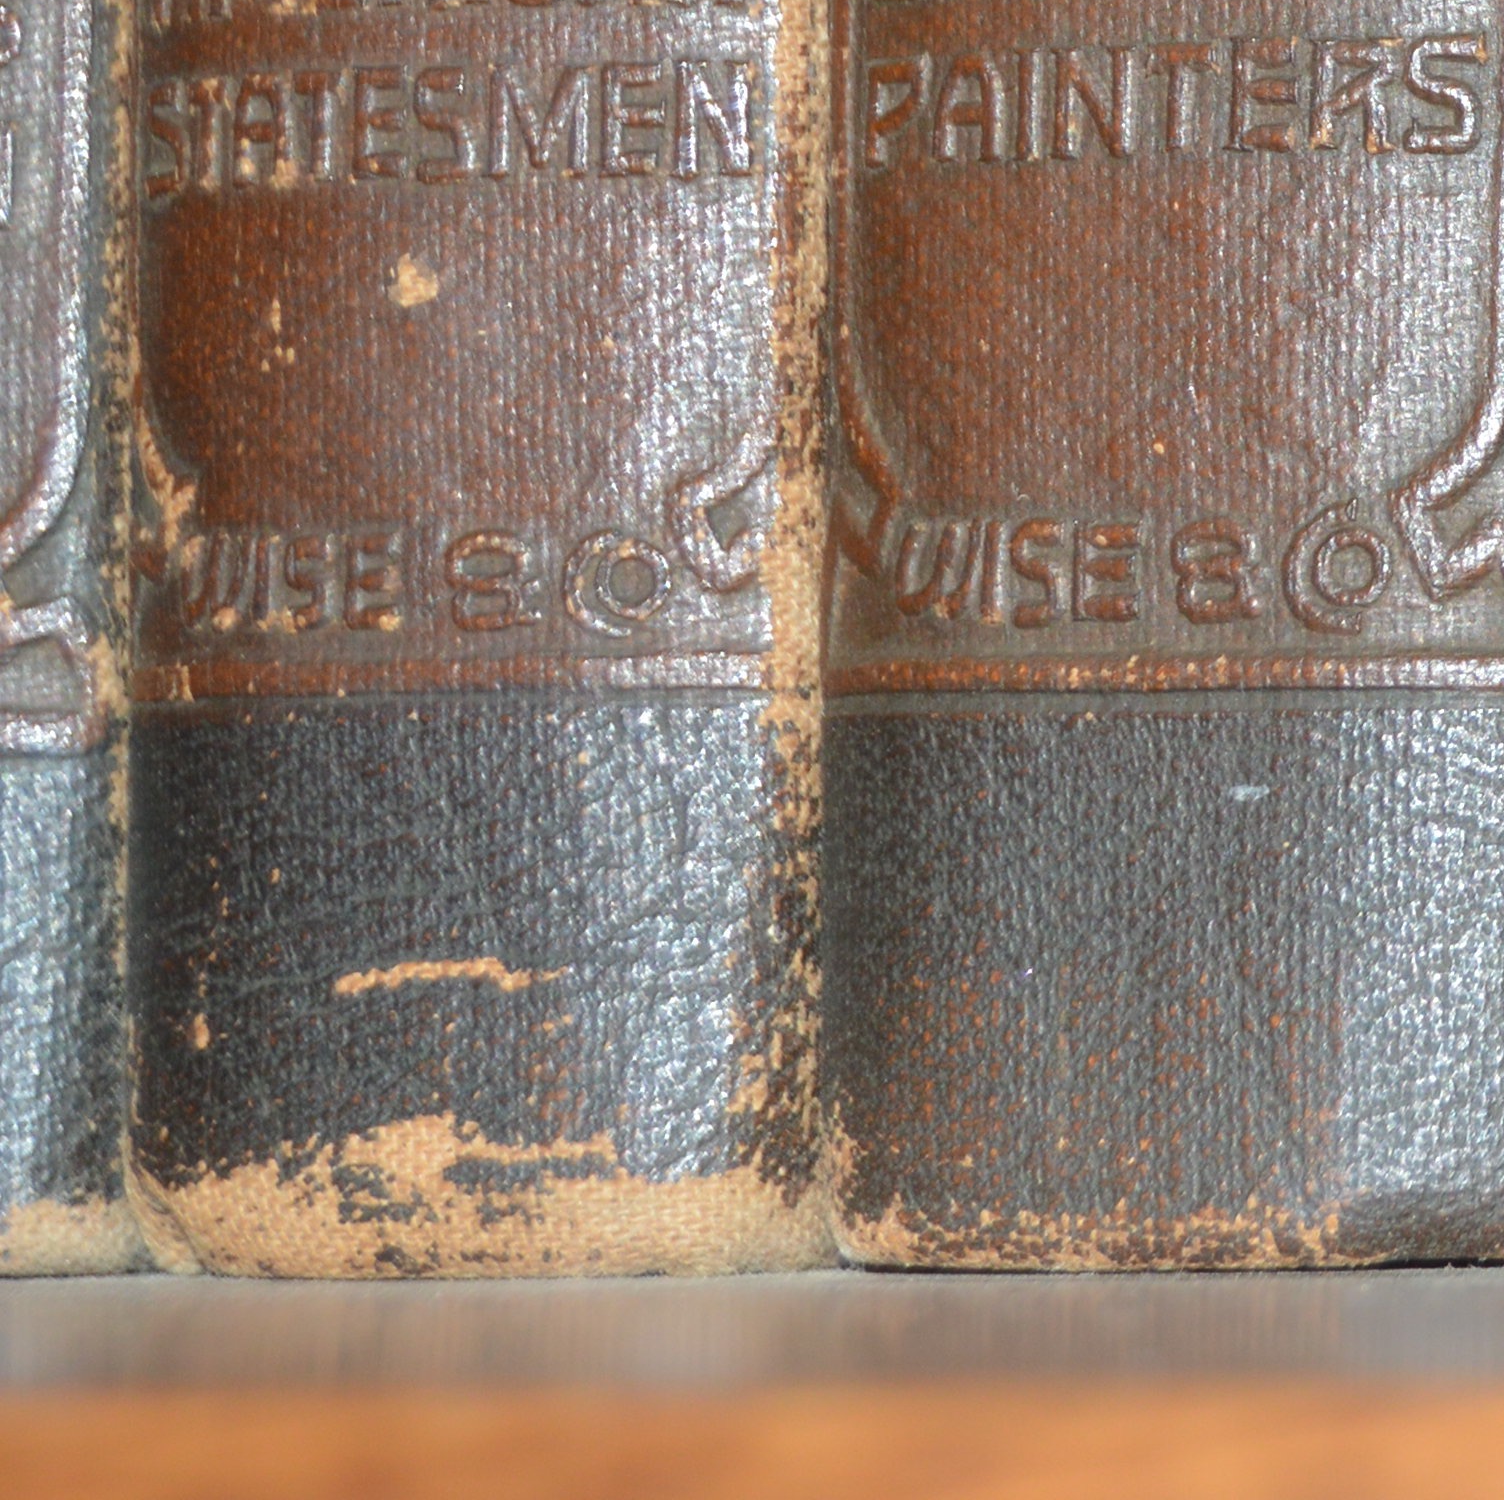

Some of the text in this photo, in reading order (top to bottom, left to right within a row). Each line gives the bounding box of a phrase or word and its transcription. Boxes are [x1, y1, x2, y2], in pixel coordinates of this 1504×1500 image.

[144, 60, 754, 200] STATESMEN
[863, 31, 1489, 170] PAINTERS
[178, 532, 400, 632] WISE
[893, 514, 1144, 630] WISE
[1170, 518, 1262, 626] &
